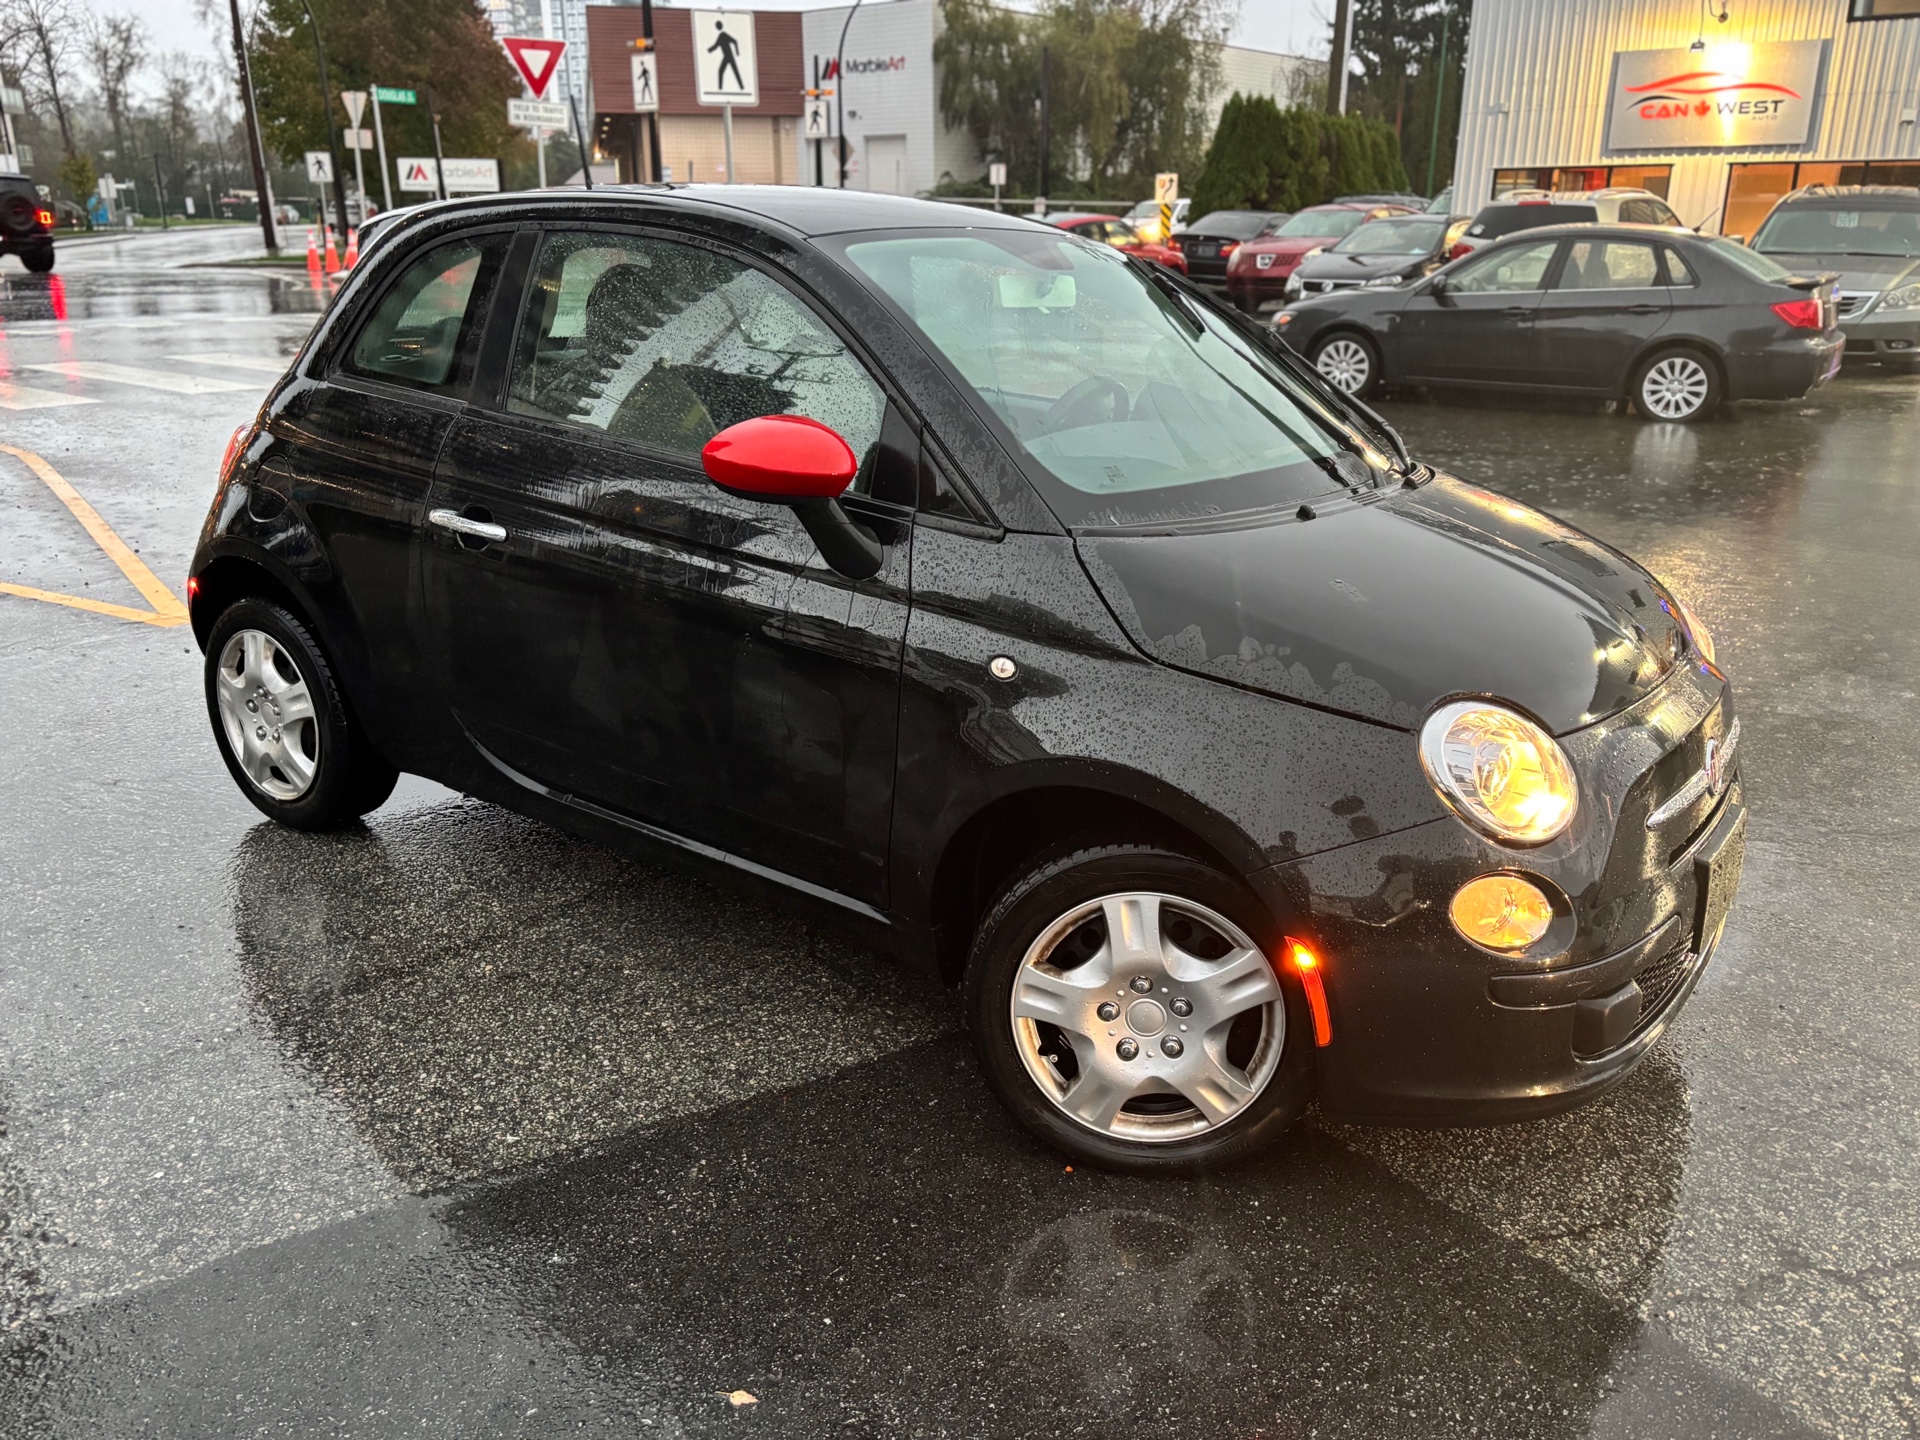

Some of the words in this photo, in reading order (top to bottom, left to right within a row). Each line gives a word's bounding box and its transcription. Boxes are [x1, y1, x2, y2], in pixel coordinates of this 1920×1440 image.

[846, 56, 905, 73] MarbleArt
[513, 104, 530, 112] YIELD
[532, 105, 540, 113] TO
[1639, 103, 1689, 120] CAN
[1717, 100, 1785, 115] WEST
